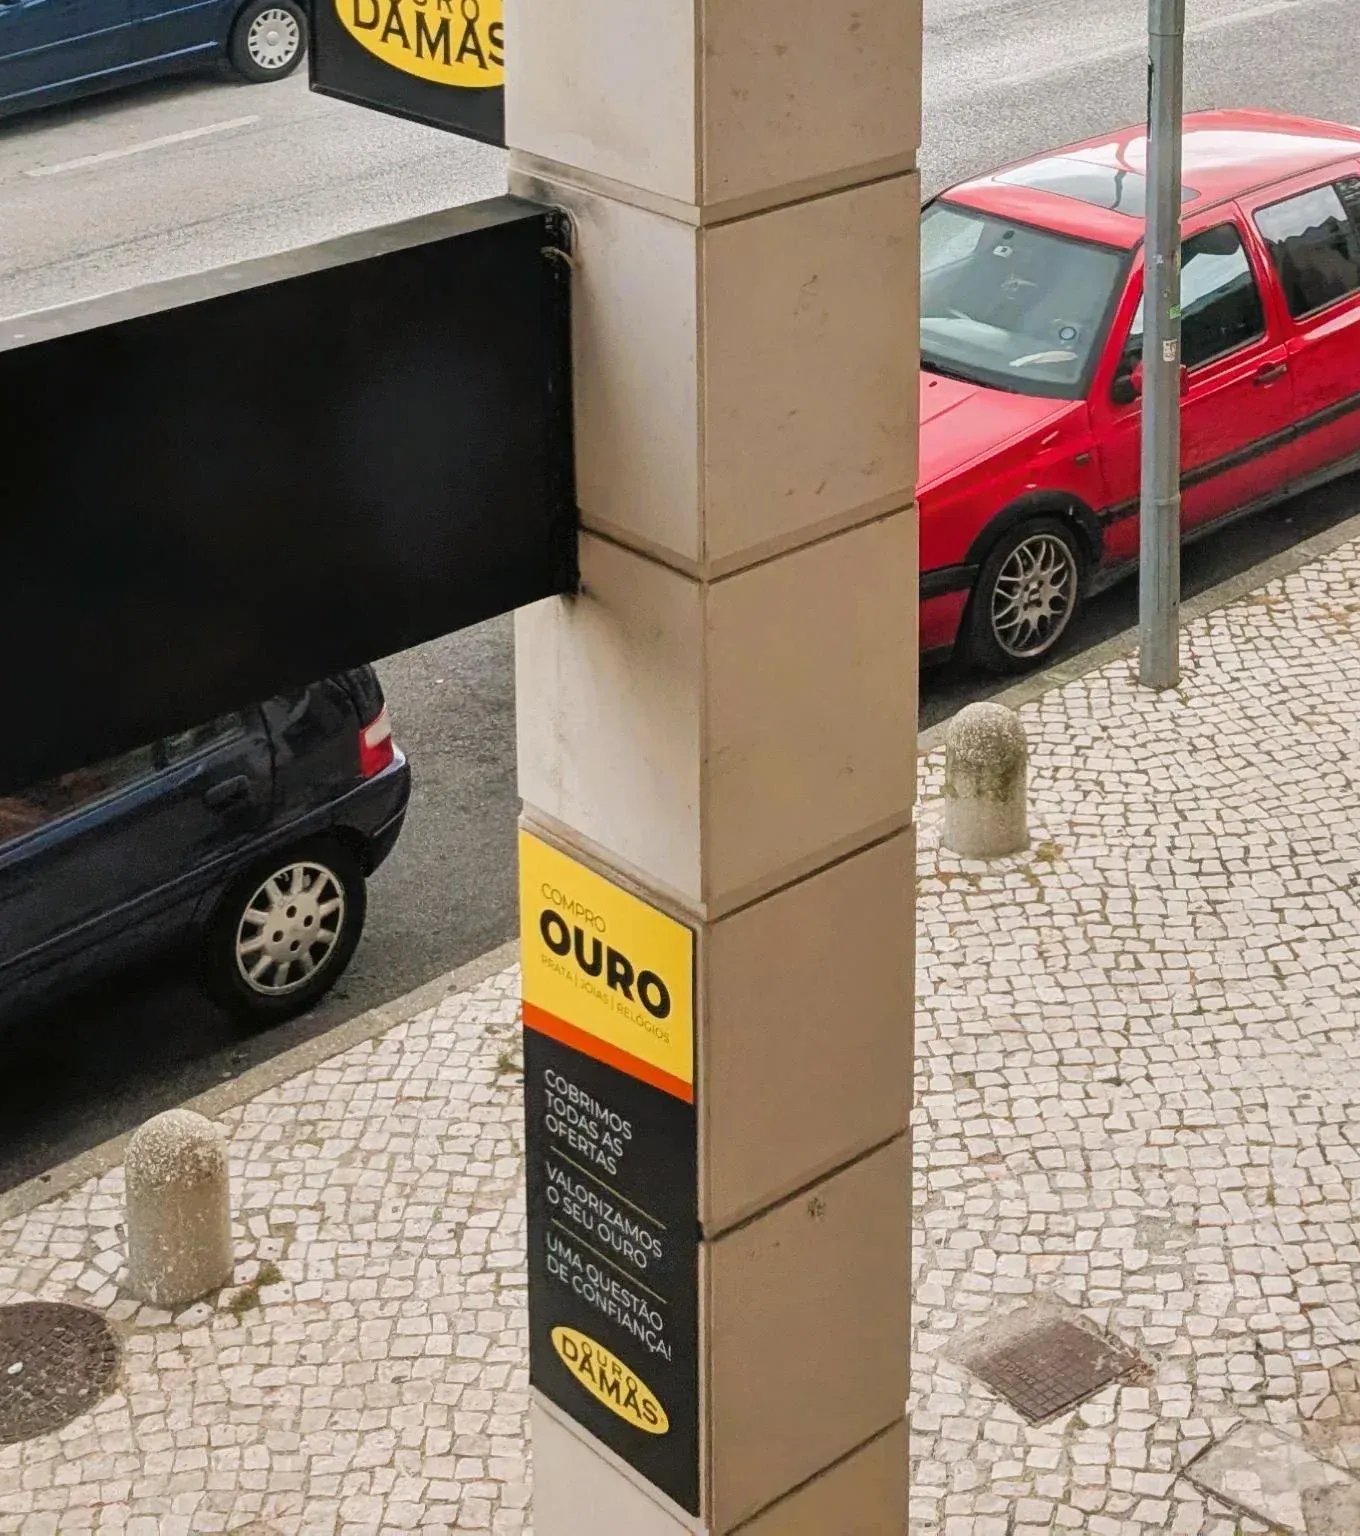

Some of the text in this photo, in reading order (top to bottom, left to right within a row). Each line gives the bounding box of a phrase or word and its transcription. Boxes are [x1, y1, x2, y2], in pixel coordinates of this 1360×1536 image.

[541, 883, 606, 933] COMPRO
[540, 909, 671, 1019] OURO
[541, 954, 573, 982] PRATA
[545, 1069, 632, 1140] COBRIMOS
[545, 1089, 623, 1157] TODAS AS
[545, 1114, 617, 1165] OFERTAS
[545, 1161, 663, 1259] VALORIZAMOS
[547, 1185, 647, 1269] O SEU OURO
[546, 1231, 664, 1332] UMA QUESTÃO
[547, 1254, 672, 1363] DE CONFIANÇA!
[562, 1332, 658, 1426] DAMAS
[581, 1341, 638, 1394] OURO
